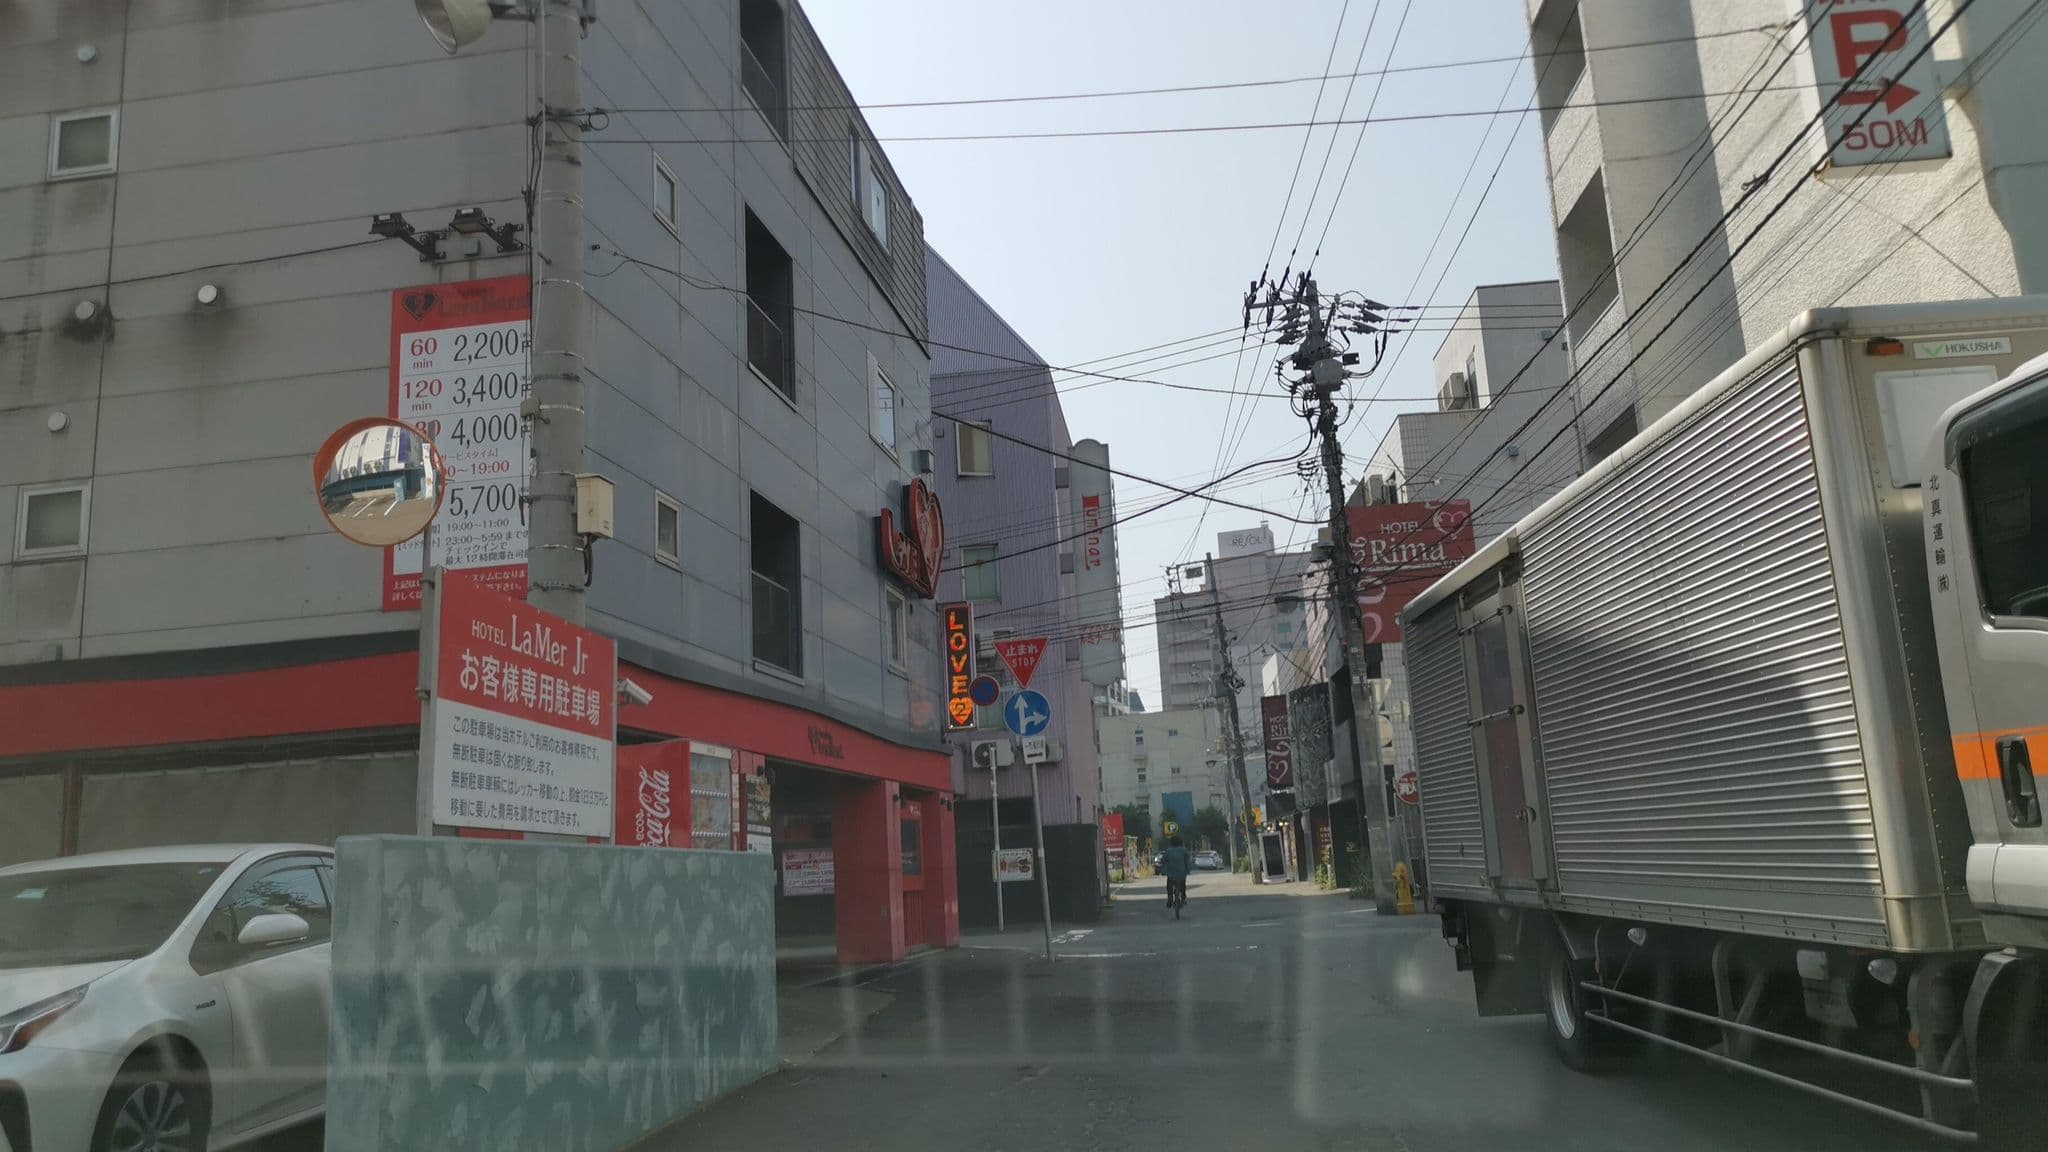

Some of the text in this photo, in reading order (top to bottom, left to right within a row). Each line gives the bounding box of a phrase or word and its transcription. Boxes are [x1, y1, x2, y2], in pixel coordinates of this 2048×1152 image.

[1830, 9, 1908, 78] P
[1843, 119, 1928, 150] 50M
[411, 338, 437, 356] 60
[1945, 341, 2003, 354] HOKUSHA
[413, 358, 433, 369] min
[404, 379, 442, 399] 120
[411, 401, 432, 412] min
[1380, 521, 1422, 535] HOTEL
[1370, 538, 1446, 564] Rima
[472, 614, 589, 676] HOTEL LaMer Jr
[949, 611, 969, 694] LOVE
[1006, 644, 1038, 657] 止まれ
[1011, 656, 1037, 669] STOP
[460, 649, 600, 725] お客様専用駐車場
